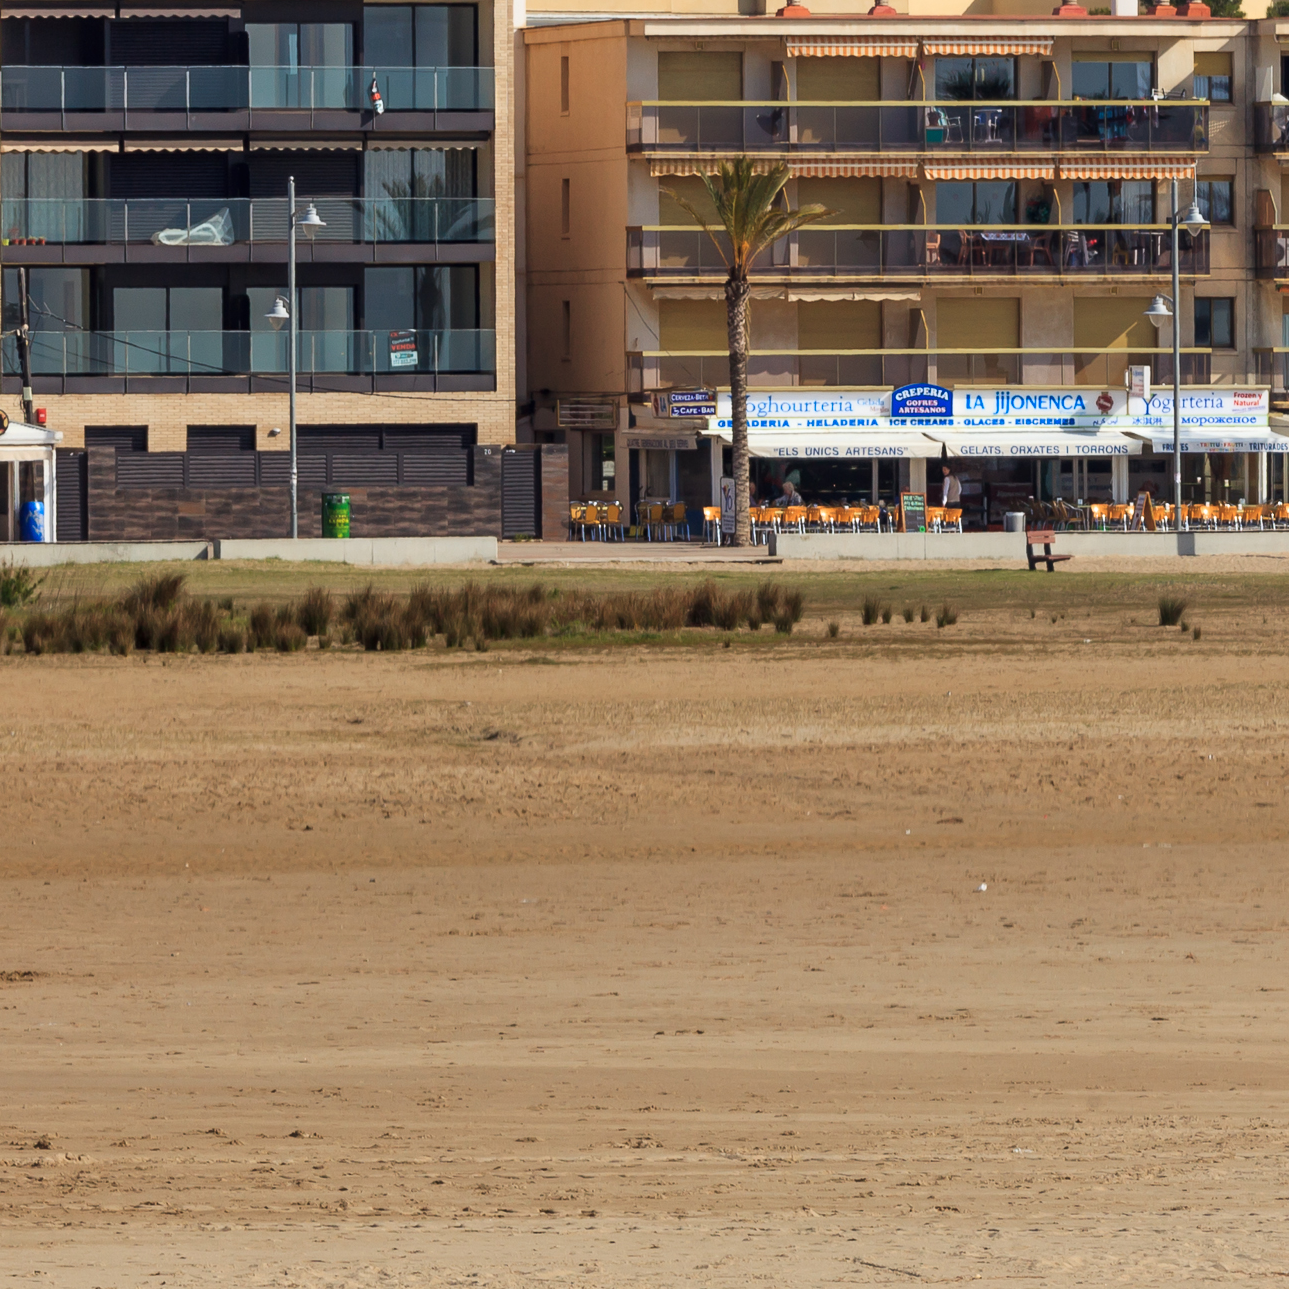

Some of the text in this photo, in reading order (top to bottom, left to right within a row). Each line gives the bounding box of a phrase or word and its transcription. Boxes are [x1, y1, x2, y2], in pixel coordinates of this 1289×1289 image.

[895, 387, 949, 401] CREPERIA
[727, 395, 853, 417] oghourteria
[965, 394, 985, 410] LA
[1142, 392, 1223, 416] Yogrteria
[701, 406, 715, 414] BAR
[898, 406, 946, 414] ARTESANOS
[718, 418, 1076, 428] GEADERIA HELADERIA ICE CREAMS GLACES EISCREMES
[1180, 416, 1257, 427] мороженое
[1010, 445, 1060, 455] ORXATES
[1075, 445, 1129, 454] TORRONS
[1162, 443, 1189, 451] FRUTES
[1249, 442, 1289, 451] TRITURADES
